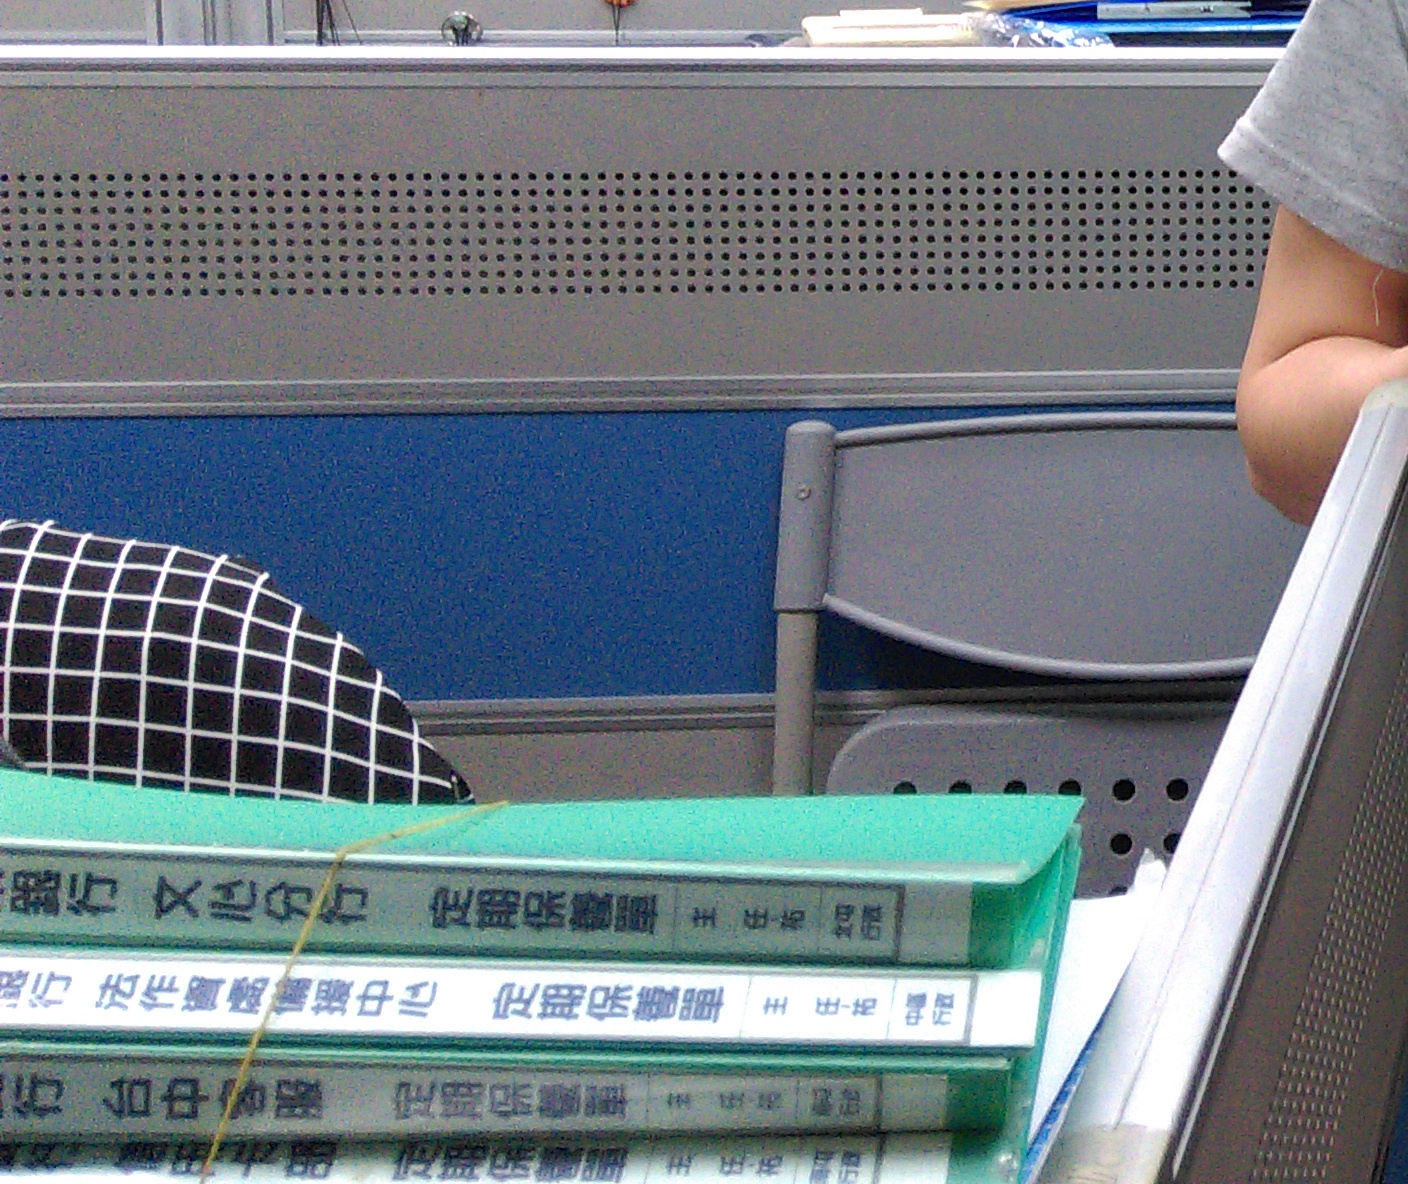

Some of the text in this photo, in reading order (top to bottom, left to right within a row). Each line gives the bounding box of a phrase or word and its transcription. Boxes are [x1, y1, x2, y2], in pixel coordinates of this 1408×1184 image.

[428, 884, 660, 936] 定期保養單
[492, 980, 725, 1025] 定期保養單
